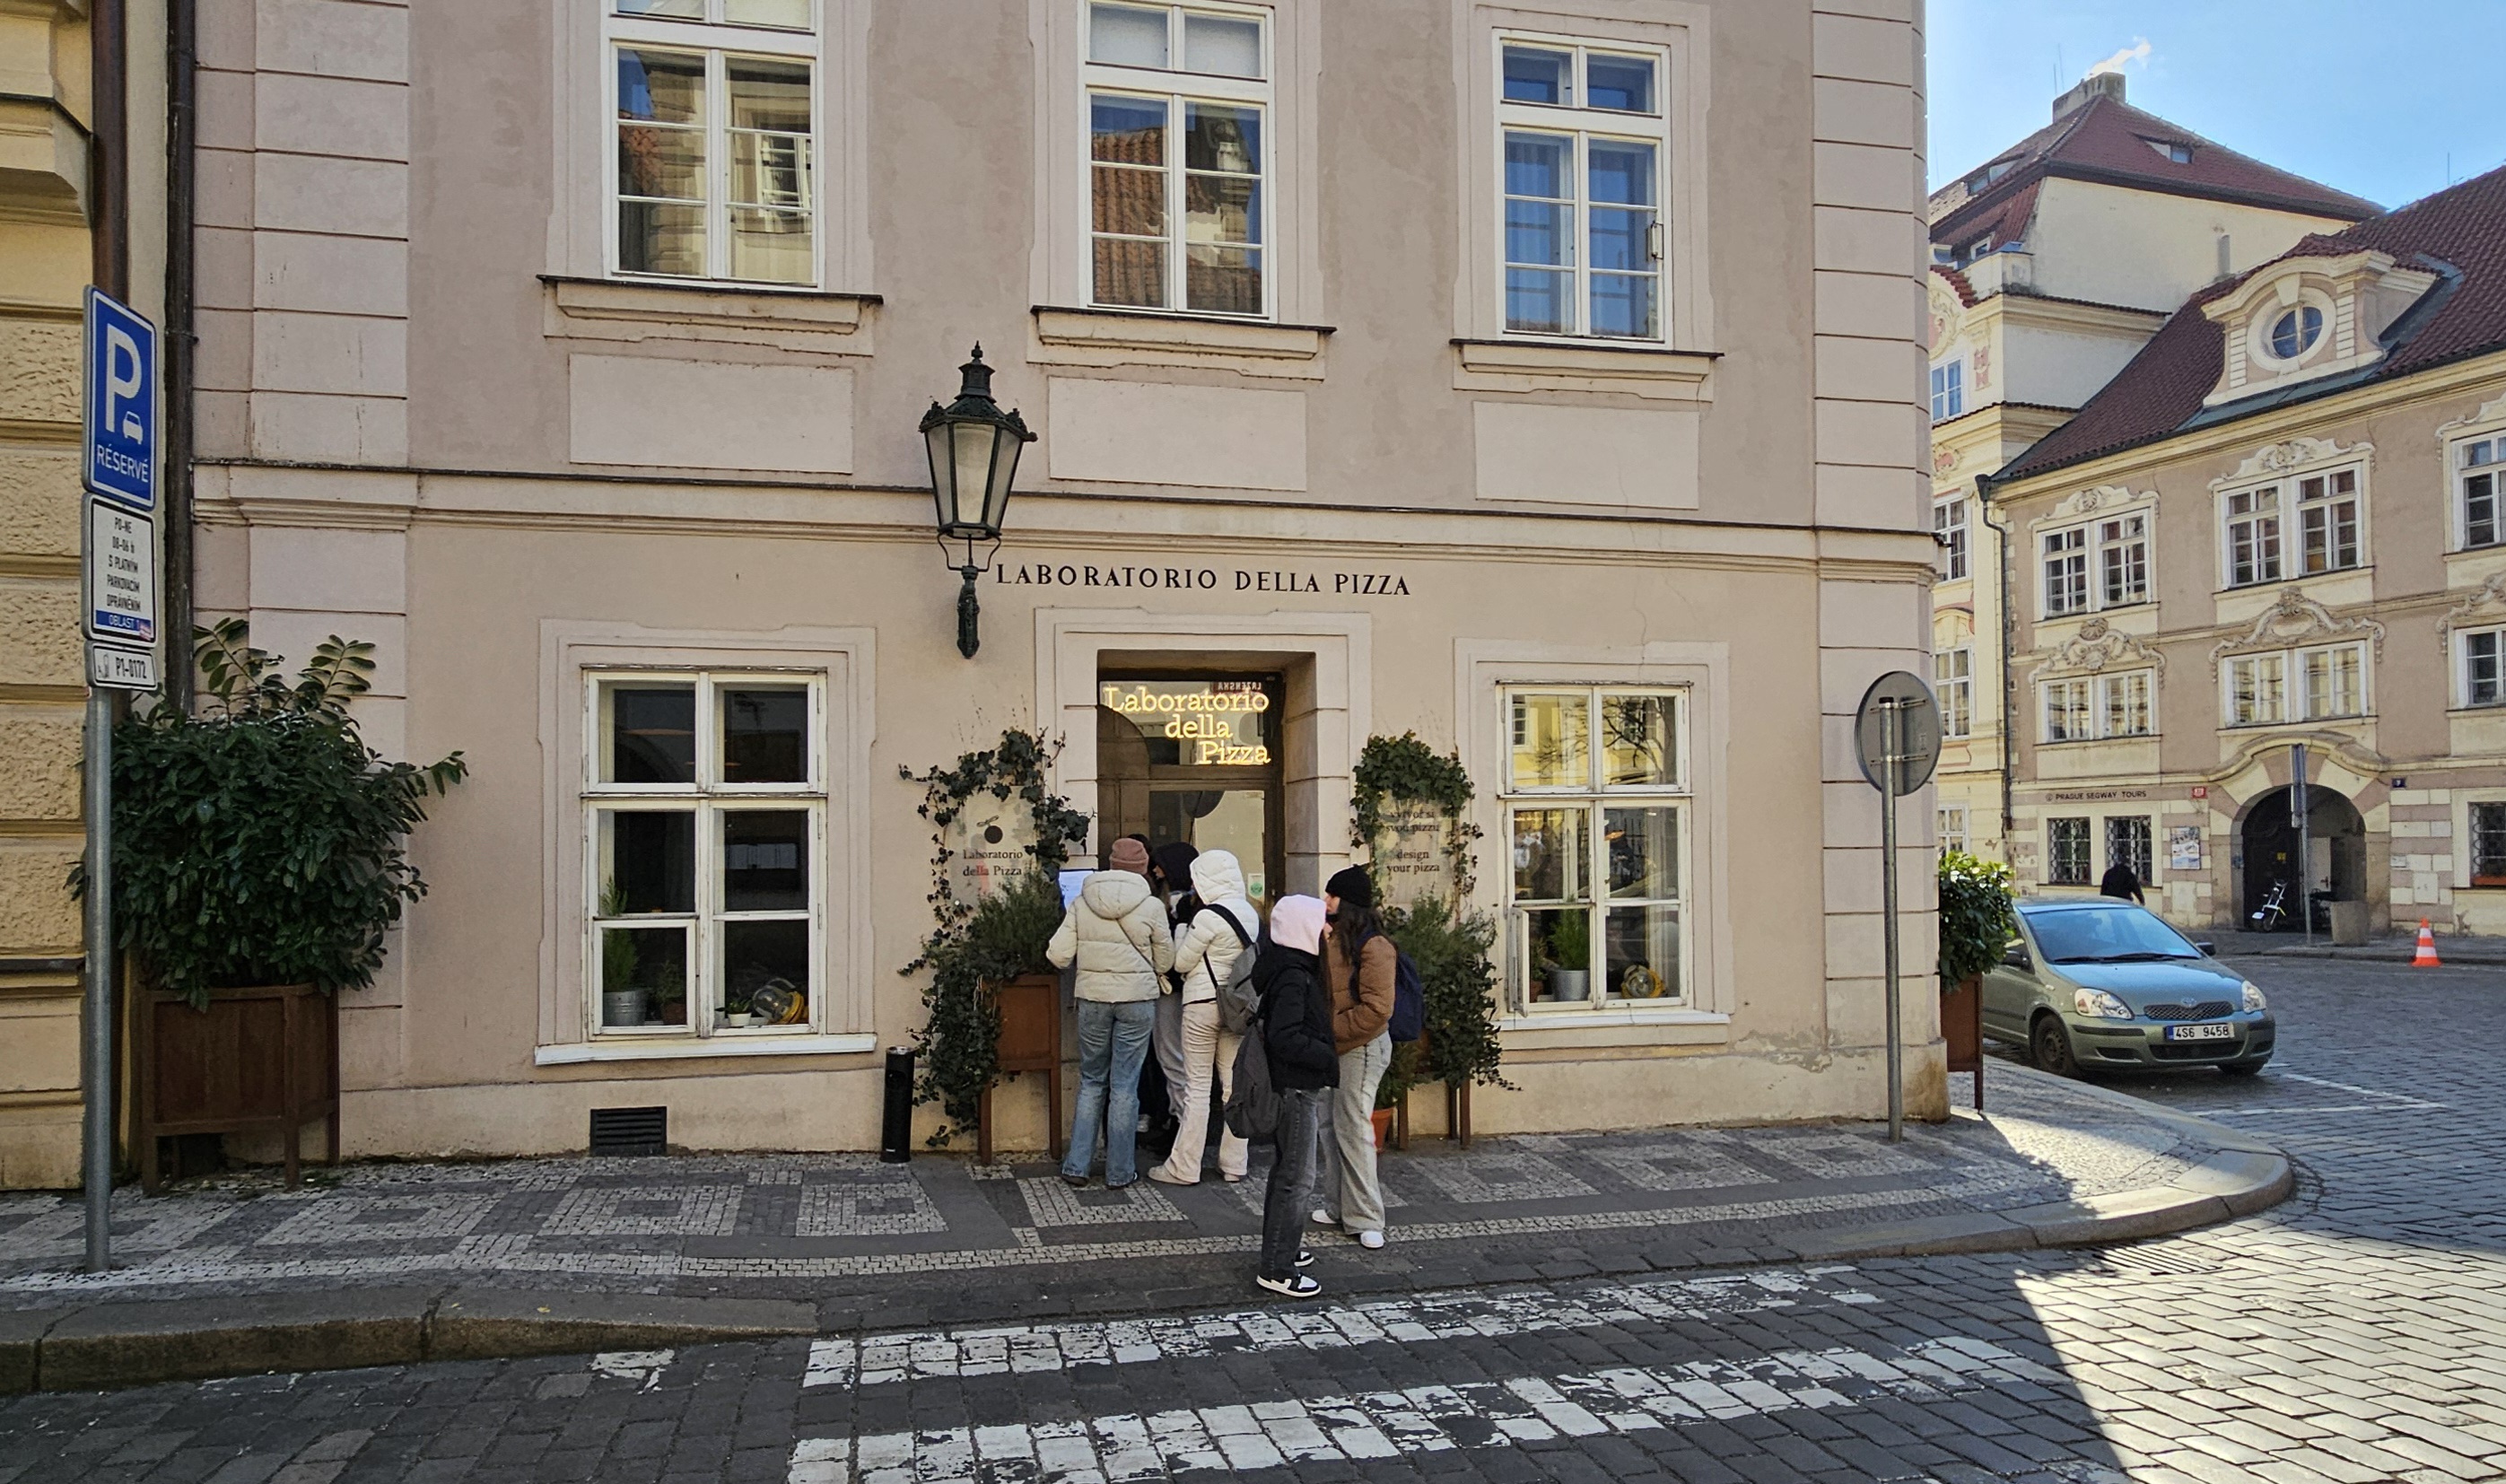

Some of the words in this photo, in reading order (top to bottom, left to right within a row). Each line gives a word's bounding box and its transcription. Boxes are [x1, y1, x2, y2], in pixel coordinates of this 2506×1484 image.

[105, 323, 143, 432] P
[96, 443, 149, 483] RÉSERVÉ
[108, 554, 113, 568] S
[996, 563, 1217, 589] LABORATORIO
[1235, 571, 1321, 593] DELLA
[1334, 573, 1411, 596] PIZZA
[109, 615, 135, 630] OBLAST
[115, 657, 147, 679] P1-0172
[1103, 685, 1270, 712] Laboratorio
[1165, 713, 1234, 739] della
[1197, 739, 1271, 765] Pizza
[2055, 792, 2084, 800] PRAGUE
[2086, 791, 2117, 799] SEGWAY
[2121, 790, 2147, 799] TOURS
[963, 849, 1024, 860] Laboratorio
[1396, 849, 1430, 861] design
[962, 865, 990, 877] della
[992, 865, 1022, 877] Pizza
[1386, 864, 1411, 876] your
[1413, 861, 1440, 875] pizza
[2176, 1027, 2196, 1038] 4S6
[2203, 1026, 2230, 1037] 9458
